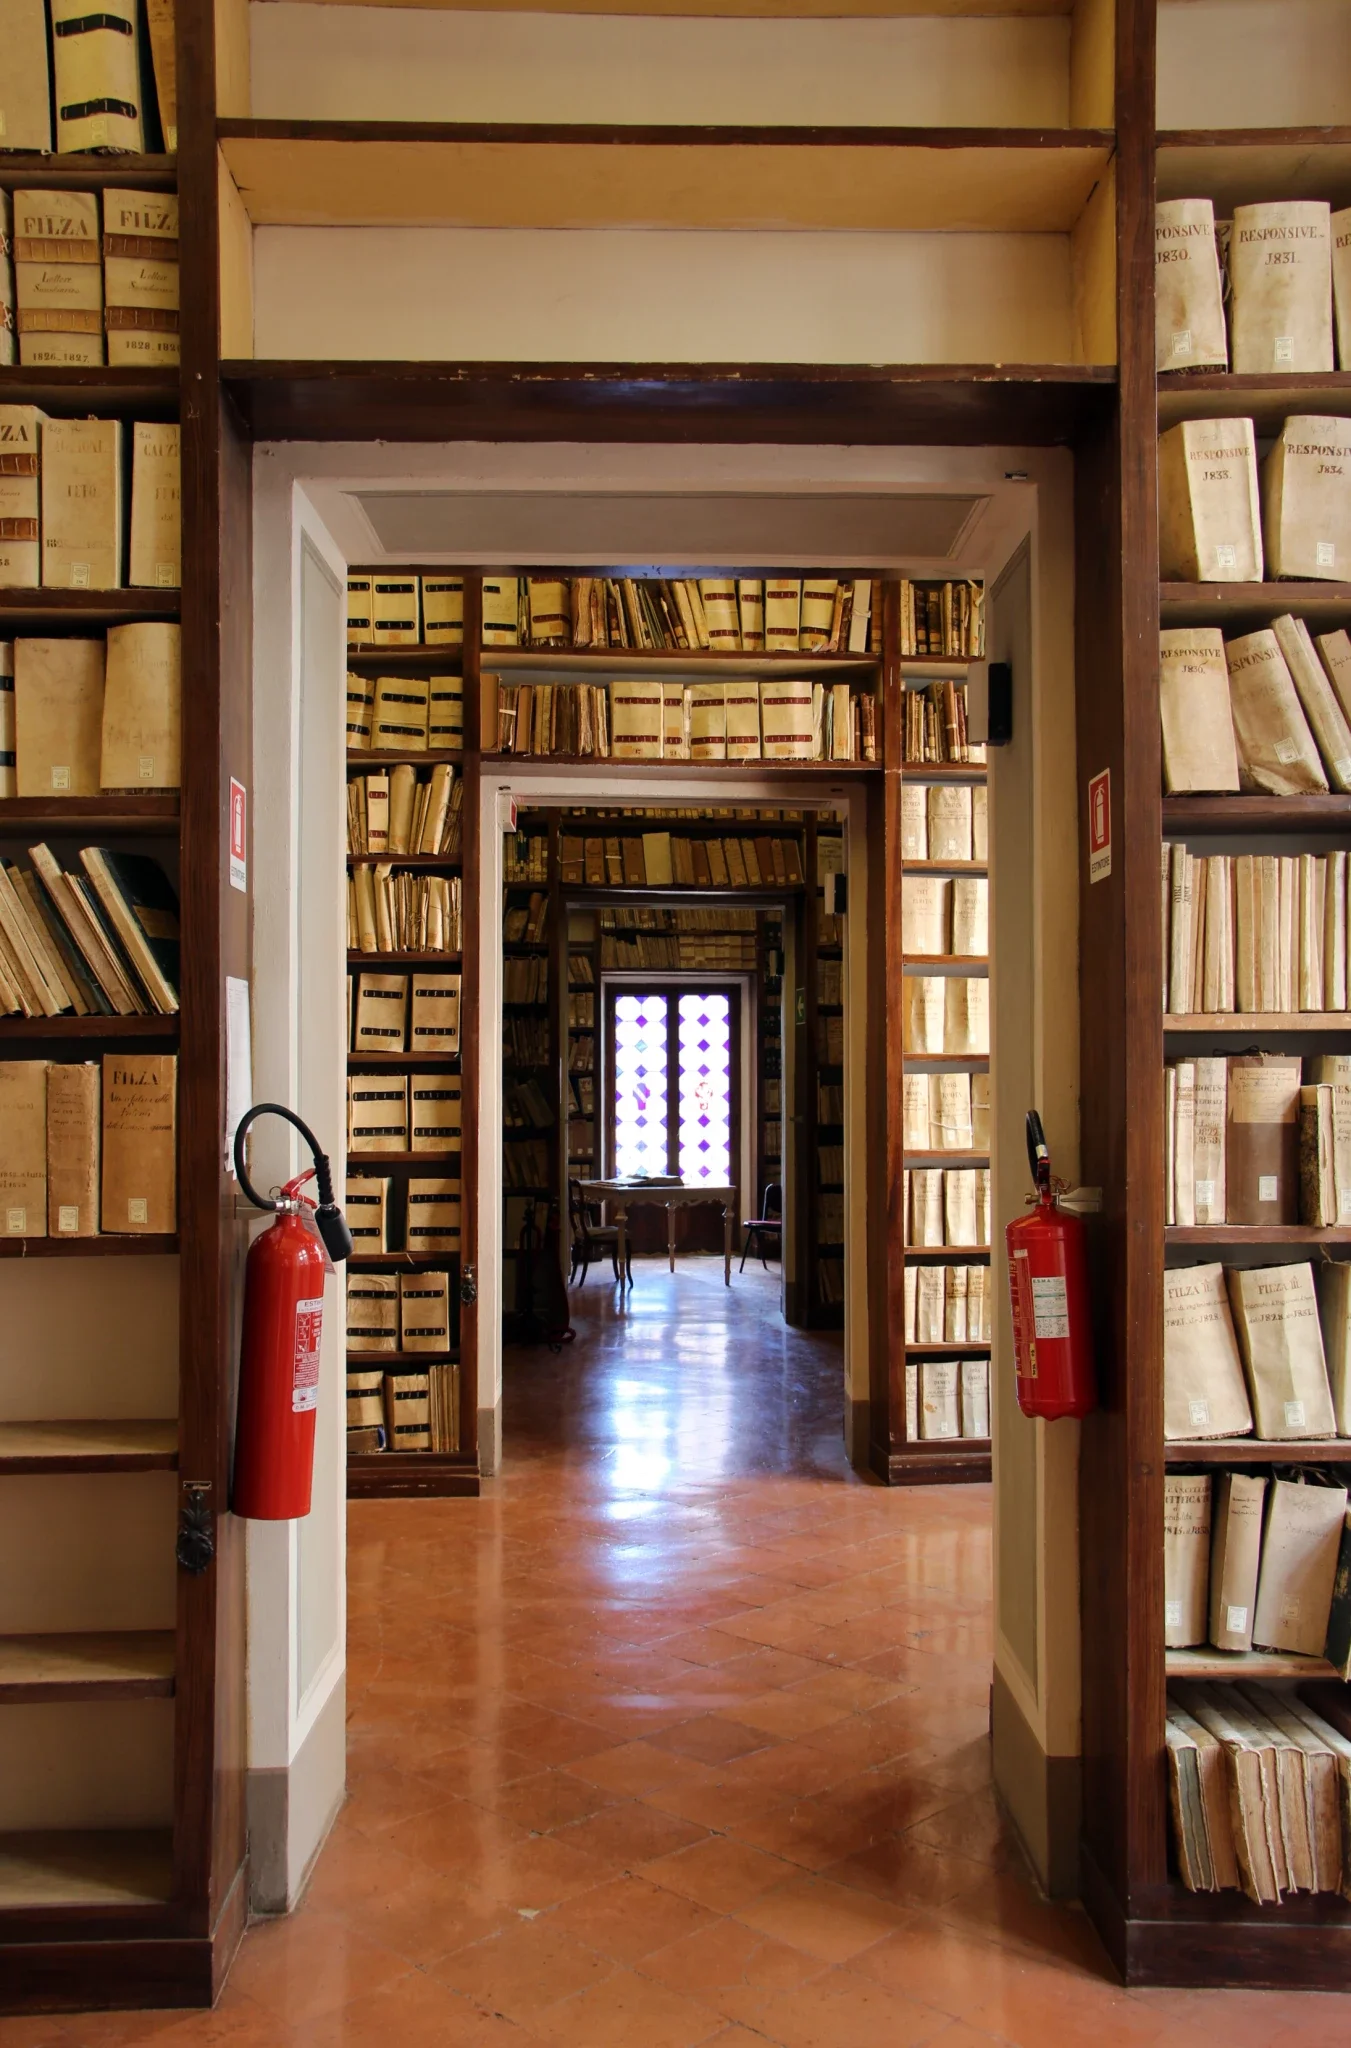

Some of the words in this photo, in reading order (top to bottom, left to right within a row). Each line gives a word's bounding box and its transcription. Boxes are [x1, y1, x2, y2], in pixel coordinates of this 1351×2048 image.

[23, 216, 89, 236] FILZA
[1160, 648, 1221, 659] RESPONSIVE
[1091, 855, 1110, 874] ESTINTORE
[113, 1071, 159, 1085] FILZA
[1168, 1285, 1200, 1299] FILZA
[1258, 1283, 1288, 1295] FILZA
